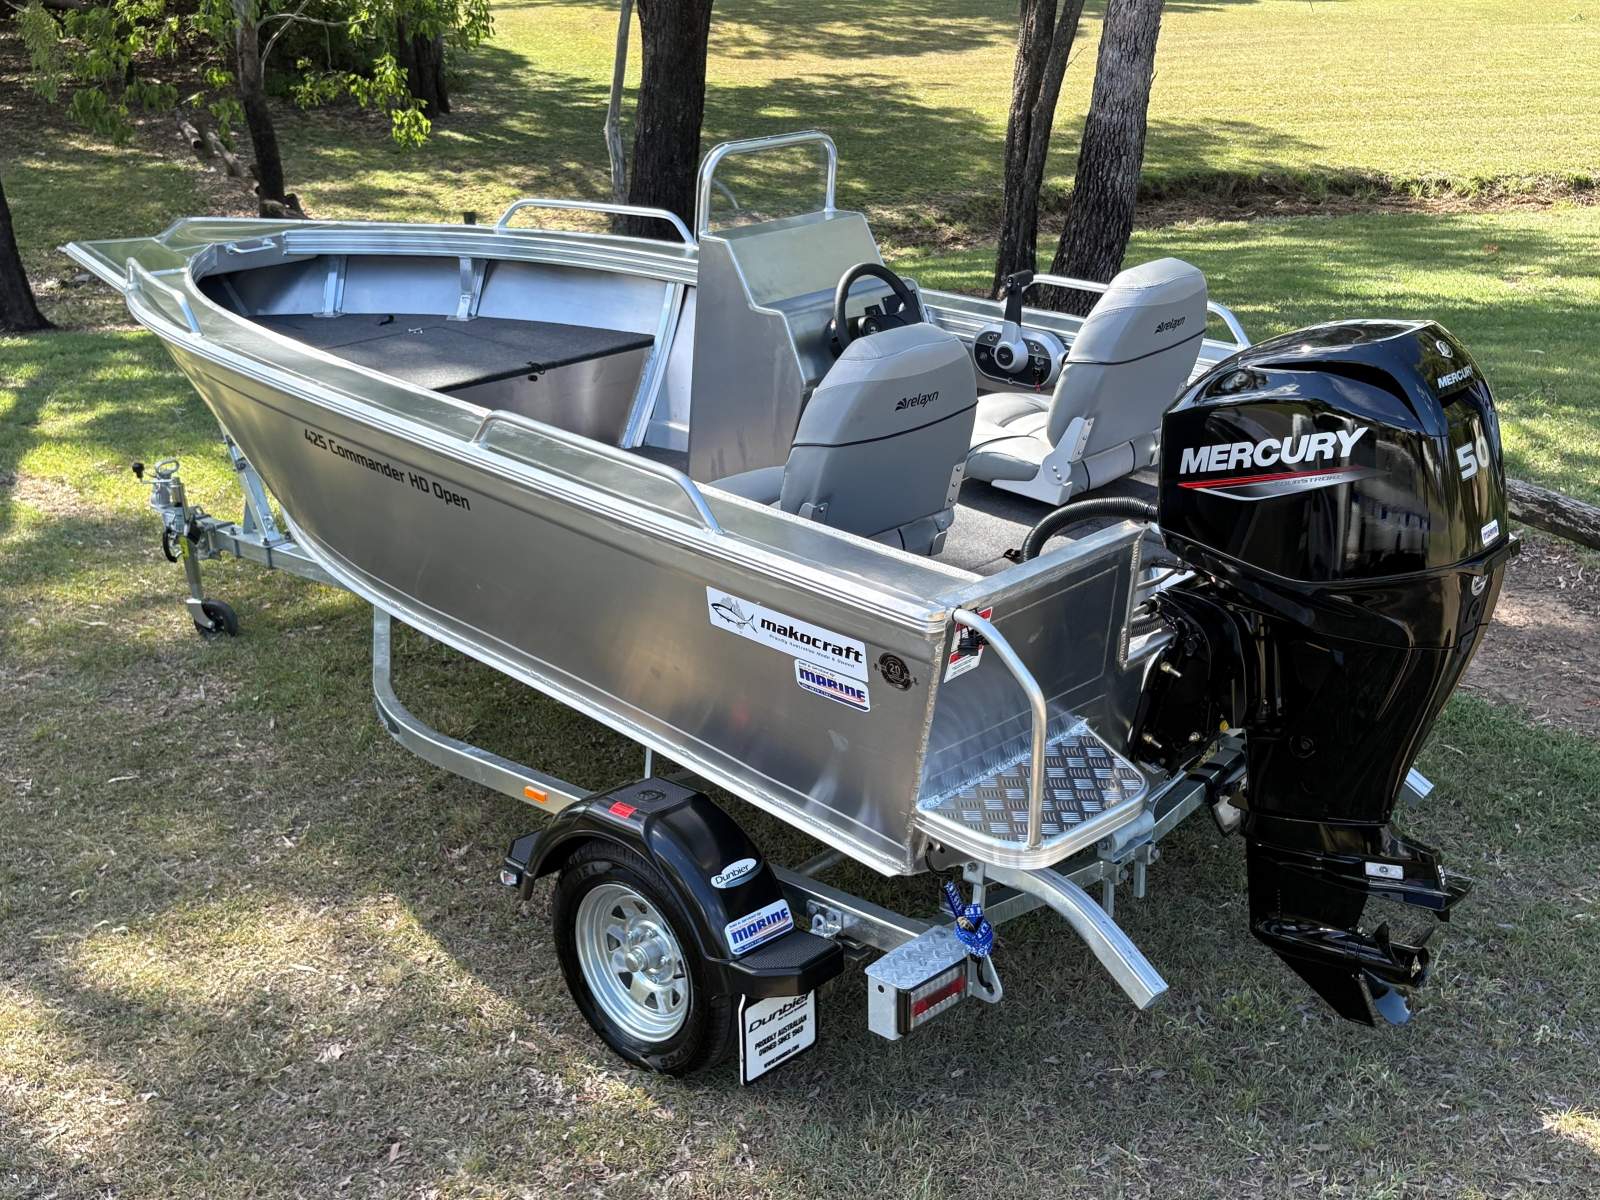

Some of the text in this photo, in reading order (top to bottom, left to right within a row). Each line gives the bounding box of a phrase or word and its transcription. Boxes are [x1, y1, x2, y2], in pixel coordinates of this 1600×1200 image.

[1437, 364, 1474, 389] MERCURY
[906, 391, 939, 408] relaxn
[304, 429, 471, 511] 425 Commander HD Open
[1179, 427, 1369, 475] MERCURY
[1456, 435, 1490, 482] 50
[760, 617, 863, 663] makocraft
[799, 668, 866, 699] MARINE
[715, 865, 749, 884] Dunbier
[731, 907, 789, 944] MARINE
[748, 993, 809, 1034] Dunbier
